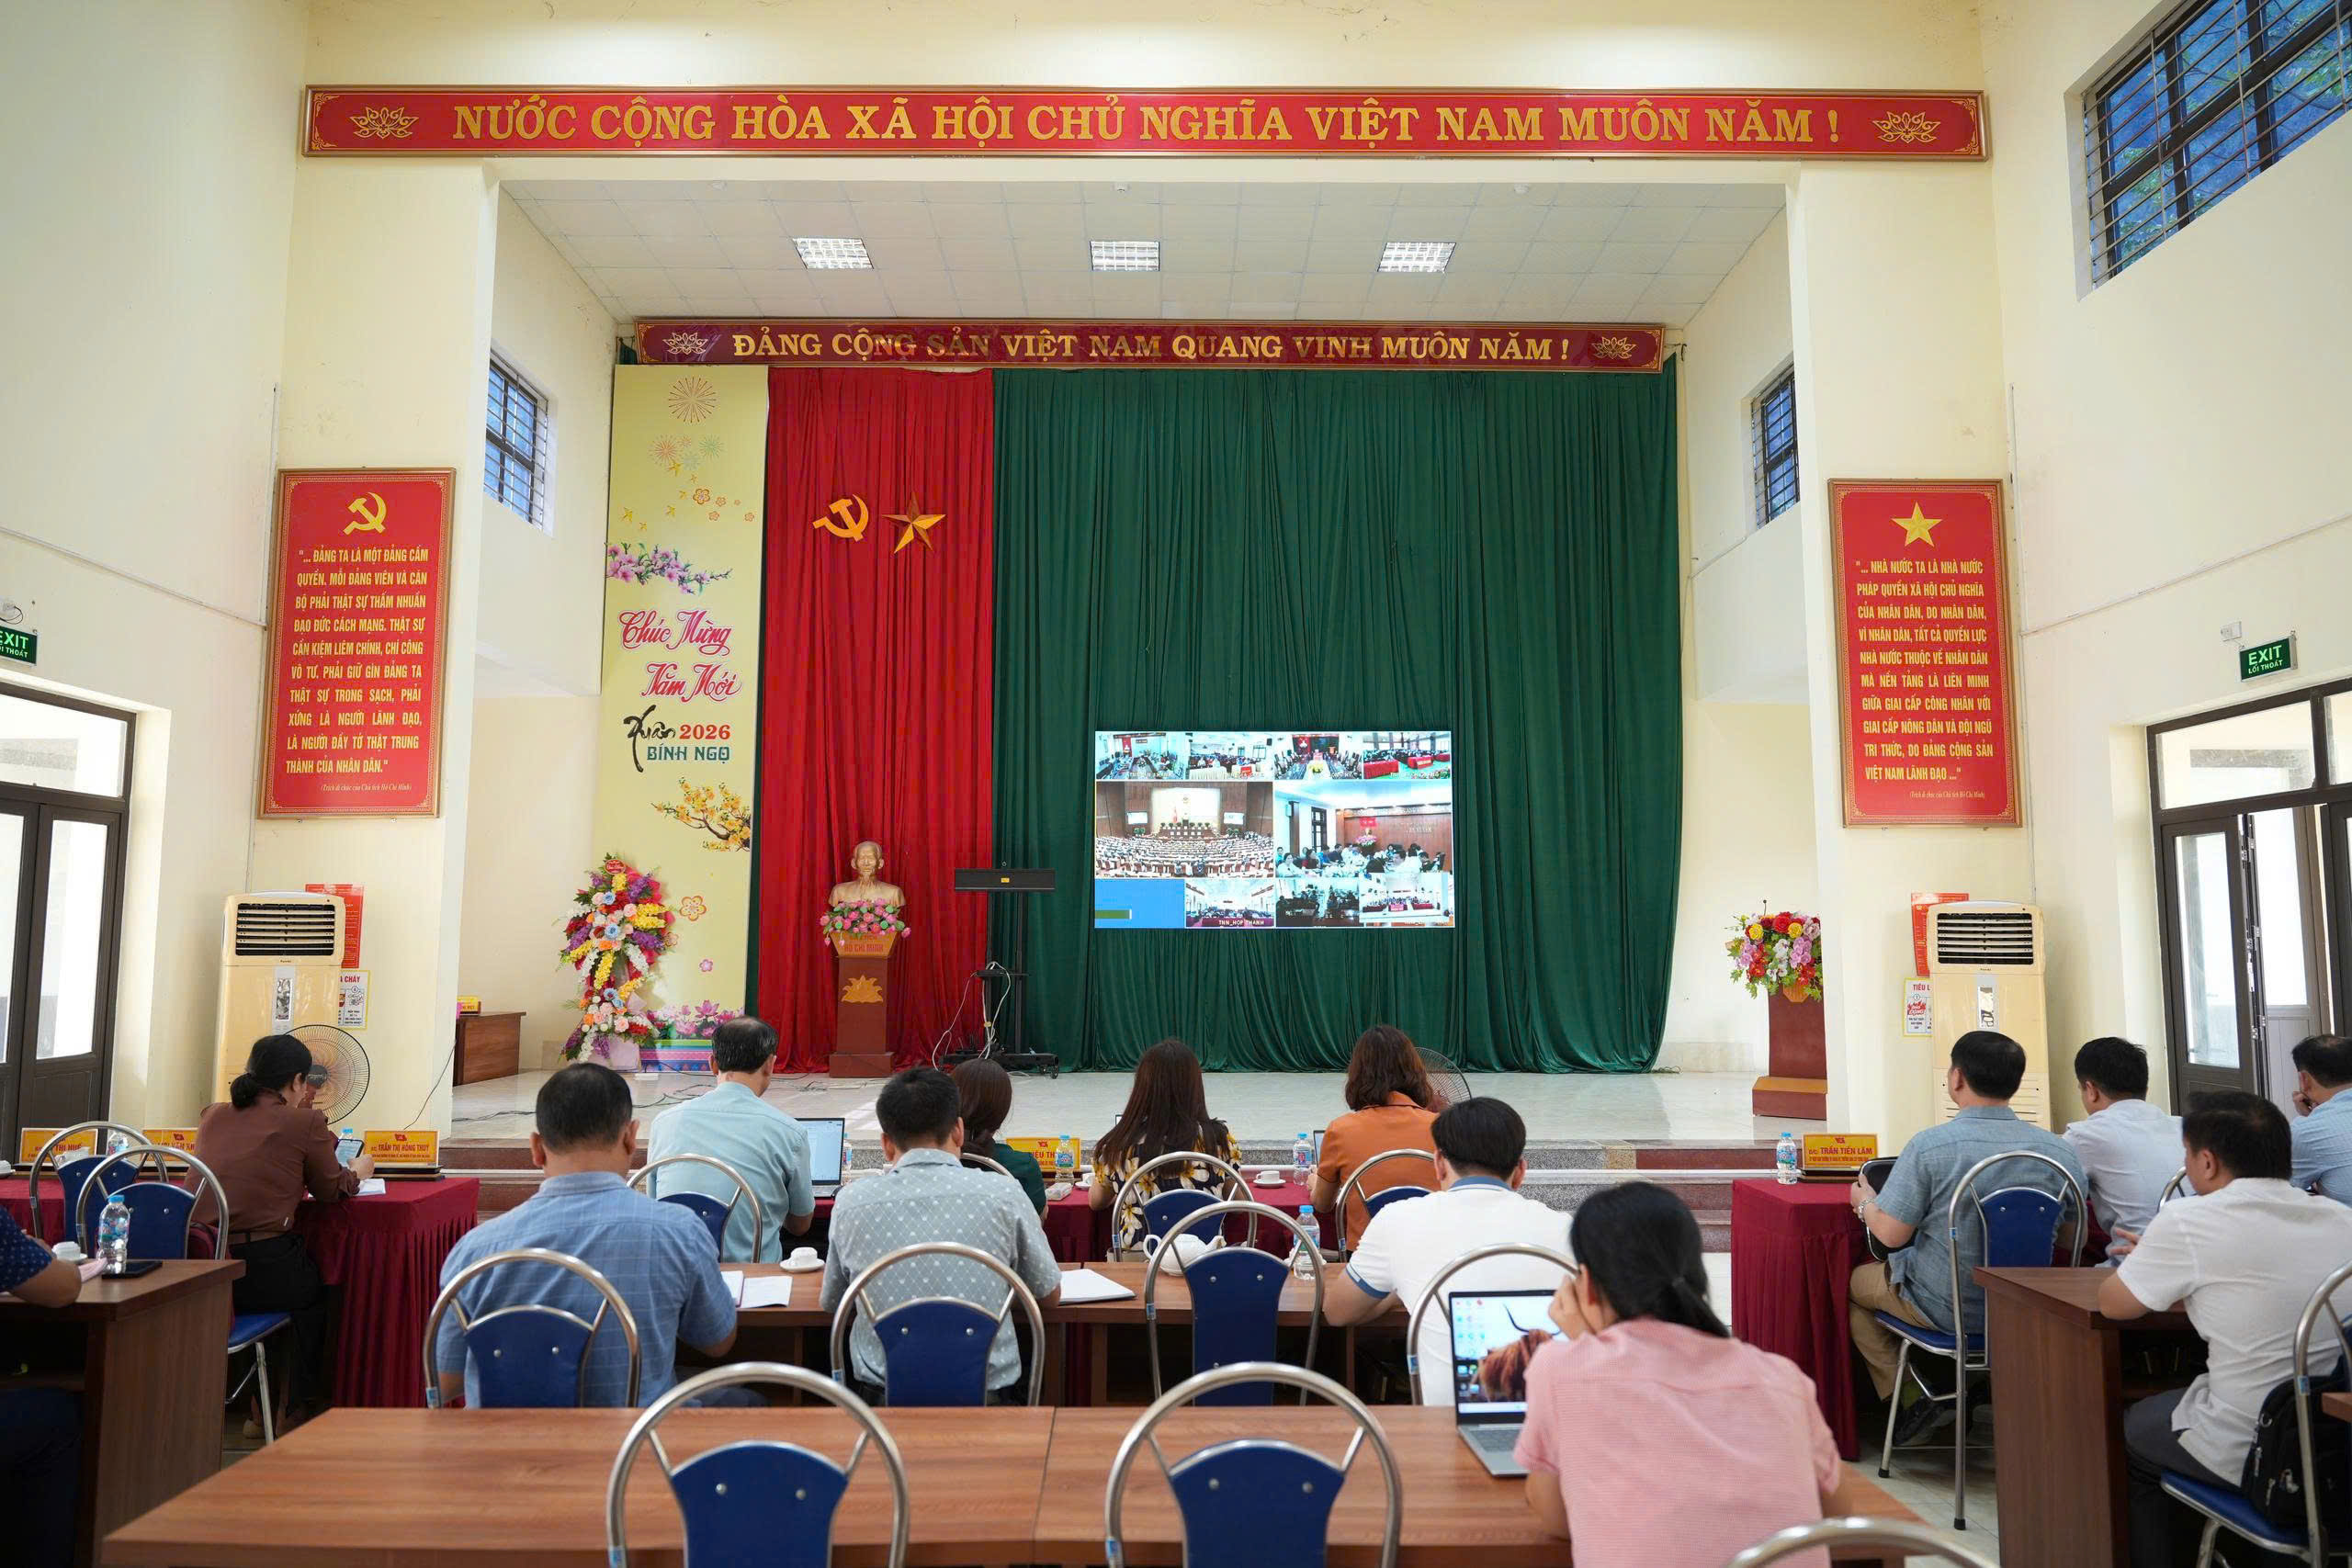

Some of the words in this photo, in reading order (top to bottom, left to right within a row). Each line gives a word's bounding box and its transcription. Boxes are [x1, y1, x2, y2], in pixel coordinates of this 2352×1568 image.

[453, 95, 577, 140] NƯỚC
[591, 96, 716, 148] CỘNG
[730, 96, 831, 140] HÒA
[845, 96, 917, 140] XÃ
[931, 96, 1014, 148] HỘI
[1027, 96, 1126, 141] CHỦ
[1139, 98, 1293, 141] NGHĨA
[1305, 97, 1420, 149] VIỆT
[1435, 107, 1544, 141] NAM
[1557, 97, 1690, 141] MUÔN
[1704, 99, 1814, 142] NĂM
[733, 326, 822, 355] ĐẢNG
[831, 328, 917, 361] CỘNG
[926, 326, 990, 357] SẢN
[1000, 328, 1078, 362] VIỆT
[1089, 334, 1161, 356] NAM
[1171, 333, 1283, 360] QUANG
[1292, 335, 1374, 358] VINH
[1380, 331, 1471, 359] MUÔN
[1477, 332, 1553, 360] NĂM
[313, 545, 336, 562] ĐẢNG
[339, 549, 348, 562] TA
[351, 547, 361, 562] LÀ
[364, 547, 382, 564] MỘT
[384, 544, 407, 561] ĐẢNG
[1871, 558, 1888, 573] NHÀ
[1891, 558, 1913, 573] NƯỚC
[1916, 561, 1926, 573] TA
[1928, 558, 1939, 573] LÀ
[1940, 559, 1958, 573] NHÀ
[1961, 558, 1983, 573] NƯỚC
[348, 568, 371, 585] ĐẢNG
[375, 570, 393, 585] VIÊN
[397, 570, 407, 584] VÀ
[410, 570, 427, 584] CÁN
[1924, 581, 1938, 598] HỘI
[1940, 580, 1956, 596] CHỦ
[1959, 582, 1984, 596] NGHĨA
[296, 594, 307, 611] BỘ
[310, 592, 329, 608] PHẢI
[333, 593, 353, 611] THẬT
[356, 594, 368, 611] SỰ
[1858, 601, 1874, 618] CỦA
[1877, 604, 1901, 618] NHÂN
[1927, 606, 1938, 618] DO
[1940, 604, 1963, 618] NHÂN
[294, 619, 311, 635] ĐẠO
[314, 616, 331, 632] ĐỨC
[334, 616, 356, 632] CÁCH
[390, 616, 410, 634] THẬT
[413, 617, 425, 634] SỰ
[619, 610, 672, 649] Chúc
[666, 610, 732, 656] Mừng
[1859, 626, 1867, 641] VÌ
[1869, 626, 1891, 641] NHÂN
[1915, 625, 1928, 641] TẤT
[1930, 625, 1941, 641] CẢ
[1972, 628, 1986, 644] LỰC
[311, 640, 332, 658] KIỆM
[334, 640, 354, 655] LIÊM
[401, 639, 424, 654] CÔNG
[1860, 649, 1877, 664] NHÀ
[1880, 649, 1902, 664] NƯỚC
[1904, 649, 1930, 667] THUỘC
[1945, 649, 1969, 664] NHÂN
[1971, 650, 1987, 664] DÂN
[2248, 645, 2282, 666] EXIT
[292, 664, 302, 679] VÔ
[323, 660, 343, 679] PHẢI
[347, 662, 362, 678] GIỮ
[366, 663, 380, 678] GÌN
[384, 660, 408, 678] ĐẢNG
[412, 665, 422, 678] TA
[2248, 663, 2260, 674] LỐI
[2260, 660, 2283, 671] THOÁT
[641, 662, 687, 696] Năm
[681, 663, 742, 703] Mới
[1861, 672, 1874, 687] MÀ
[1902, 670, 1923, 688] TẢNG
[1928, 672, 1939, 687] LÀ
[1944, 672, 1962, 687] LIÊN
[1967, 675, 1989, 687] MINH
[290, 687, 311, 705] THẬT
[317, 688, 330, 705] SỰ
[335, 689, 363, 702] TRONG
[401, 683, 421, 702] PHẢI
[1885, 698, 1902, 710] GIAI
[1905, 694, 1921, 710] CẤP
[1925, 695, 1948, 710] CÔNG
[1951, 695, 1973, 710] NHÂN
[1977, 694, 1990, 710] VỚI
[288, 710, 311, 726] XỨNG
[320, 710, 330, 726] LÀ
[338, 709, 364, 726] NGƯỜI
[372, 710, 394, 726] LÃNH
[1863, 720, 1880, 733] GIAI
[1883, 716, 1898, 733] CẤP
[1901, 718, 1924, 733] NÔNG
[1927, 718, 1943, 734] DÂN
[1946, 719, 1956, 733] VÀ
[1959, 719, 1973, 736] ĐỘI
[679, 724, 731, 740] 2026
[288, 735, 297, 750] LÀ
[301, 734, 327, 750] NGƯỜI
[367, 734, 388, 751] THẬT
[391, 736, 419, 749] TRUNG
[1908, 744, 1919, 757] DO
[1923, 739, 1946, 757] ĐẢNG
[1950, 742, 1972, 759] CỘNG
[1976, 739, 1993, 757] SẢN
[647, 742, 688, 761] BÍNH
[694, 746, 730, 764] NGỌ
[287, 759, 313, 773] THÀNH
[317, 755, 333, 773] CỦA
[336, 757, 360, 773] NHÂN
[1865, 764, 1883, 783] VIỆT
[1884, 767, 1904, 780] NAM
[1906, 765, 1928, 780] LÃNH
[1929, 768, 1947, 783] ĐẠO
